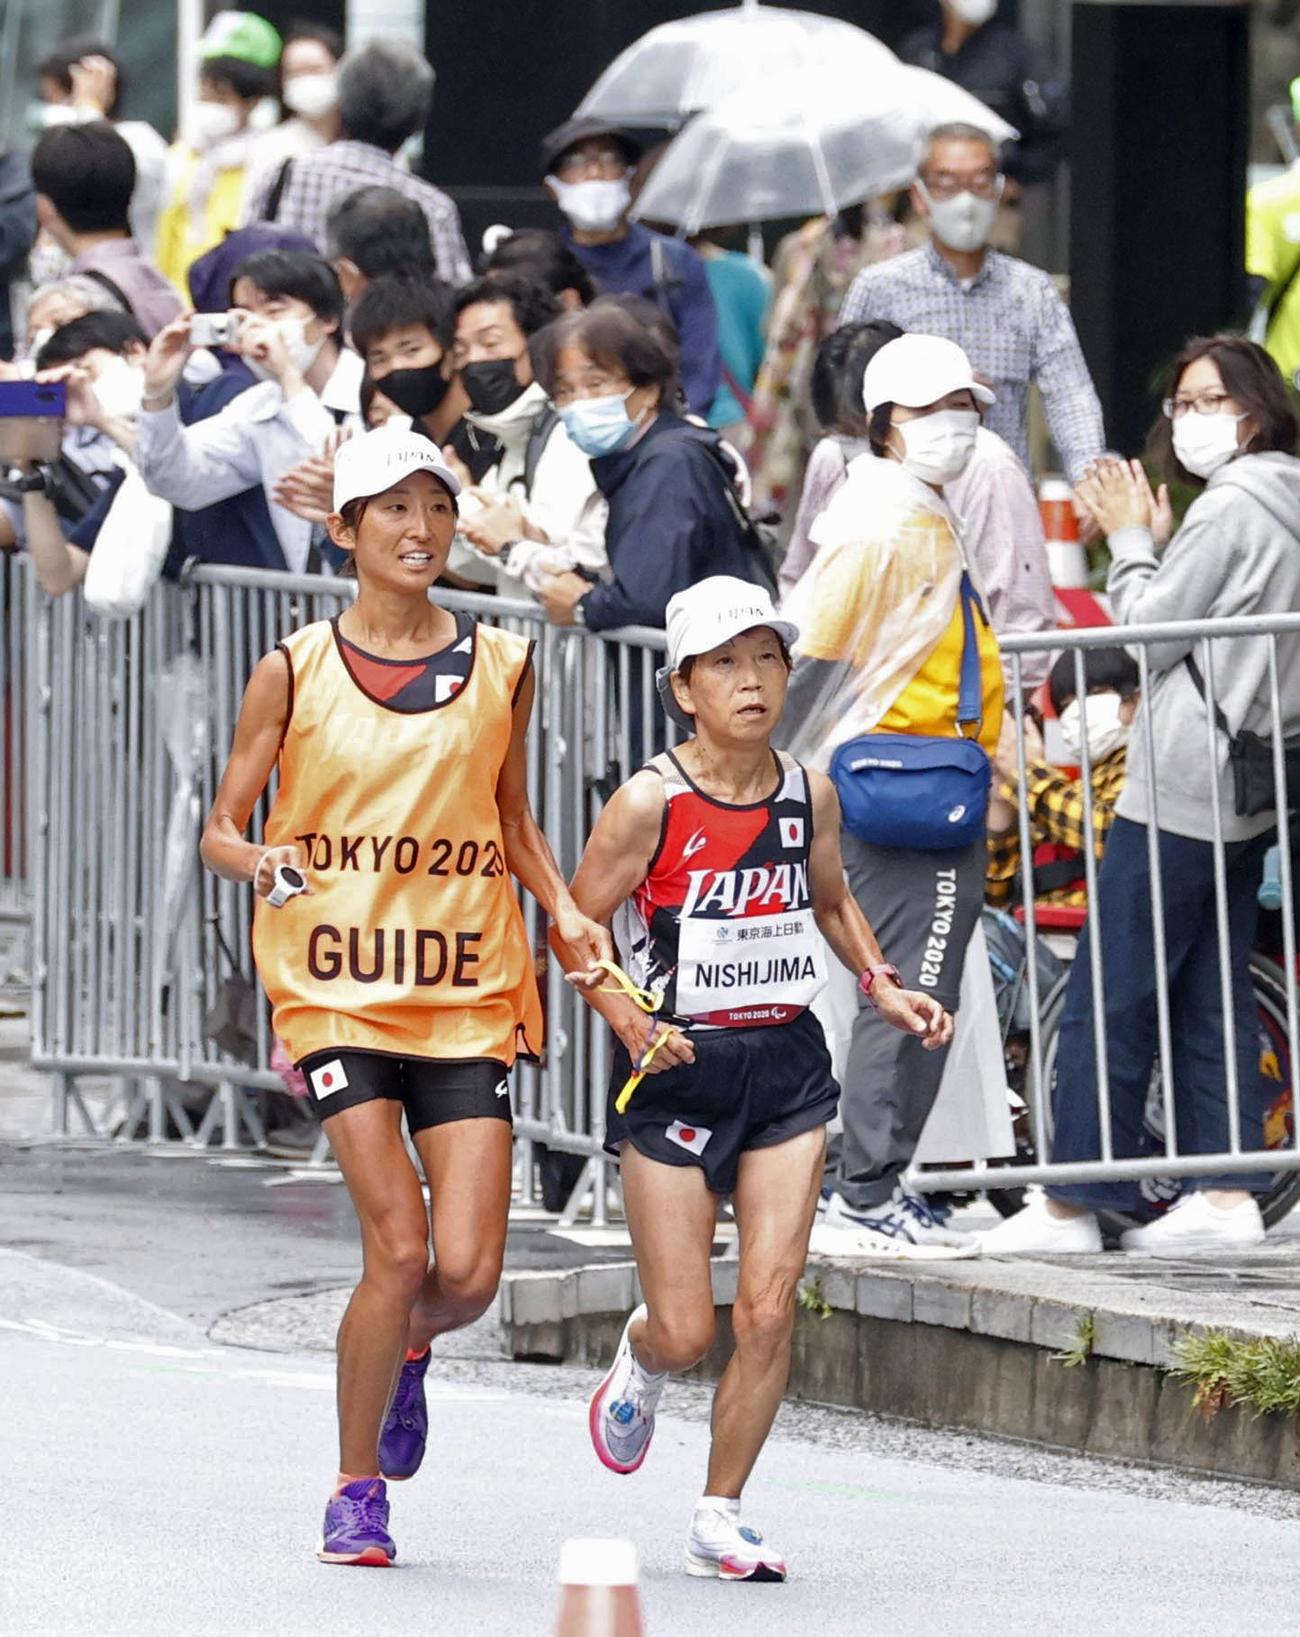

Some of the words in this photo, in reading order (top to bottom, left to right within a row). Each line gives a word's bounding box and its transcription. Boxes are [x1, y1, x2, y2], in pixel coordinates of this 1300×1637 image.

[295, 833, 420, 874] TOKYO
[676, 858, 809, 919] JAPAN
[932, 868, 957, 935] TOKYO
[737, 921, 804, 941] 東京海上日動
[308, 924, 483, 987] GUIDE
[695, 955, 816, 988] NISHIJIMA
[919, 936, 947, 987] 2020
[728, 1011, 752, 1020] TOKYO
[752, 1009, 770, 1019] 2020
